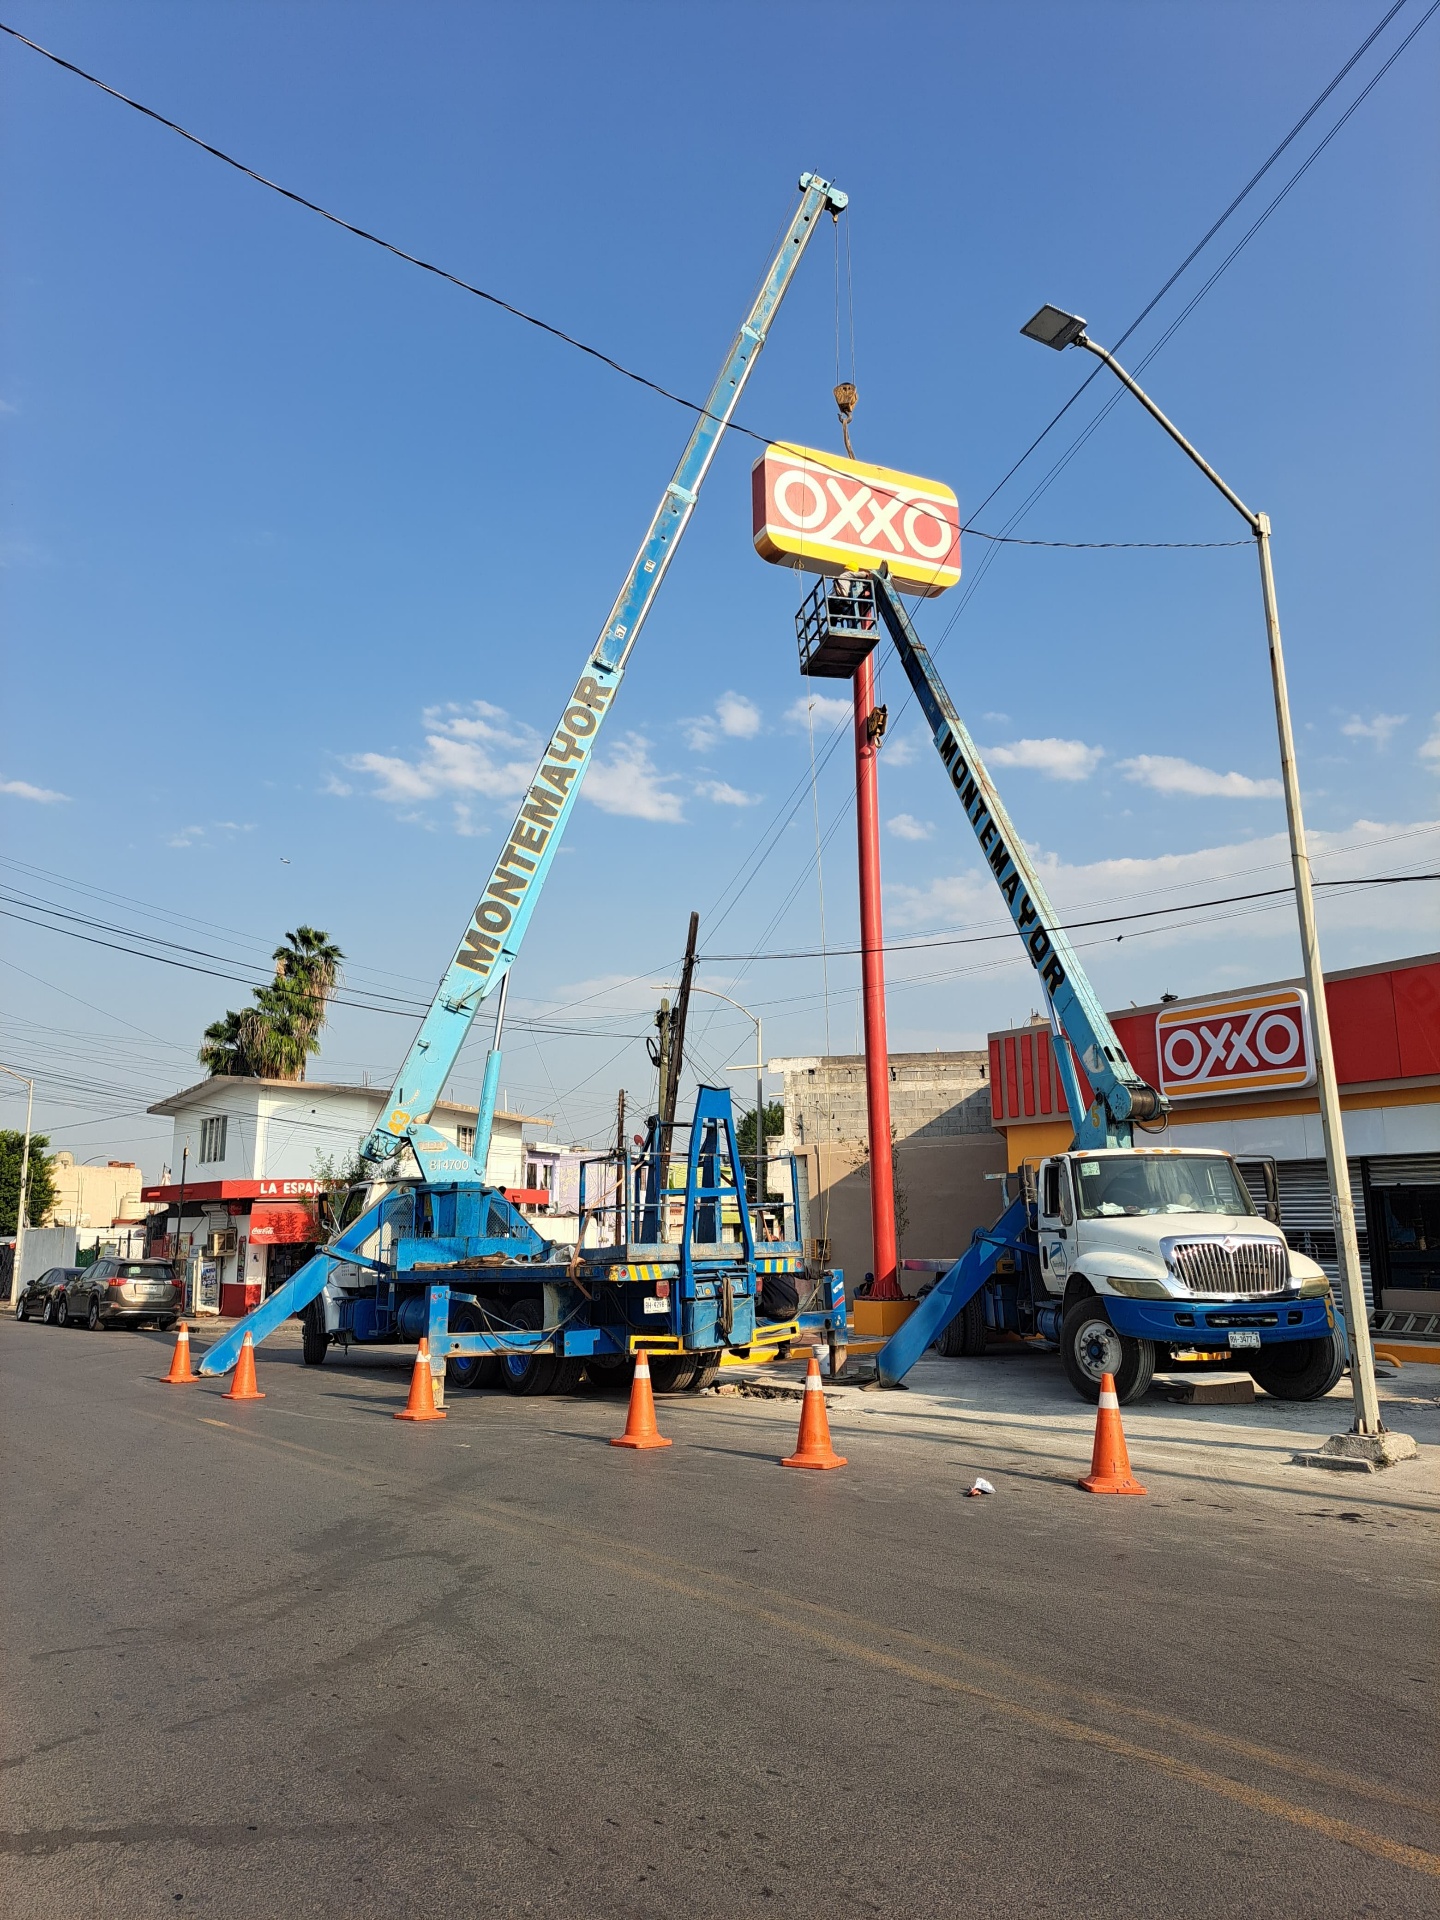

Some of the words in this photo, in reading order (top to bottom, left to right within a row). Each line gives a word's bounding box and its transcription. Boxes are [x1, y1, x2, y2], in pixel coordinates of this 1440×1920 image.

[773, 469, 953, 560] OXXO
[615, 624, 627, 639] 57
[455, 675, 615, 978] MONTEMAYOR
[938, 729, 1066, 997] MONTEMAYOR
[1164, 1011, 1300, 1078] OXXO
[388, 1109, 411, 1136] 43
[1091, 1105, 1101, 1128] 5
[260, 1182, 278, 1194] LA
